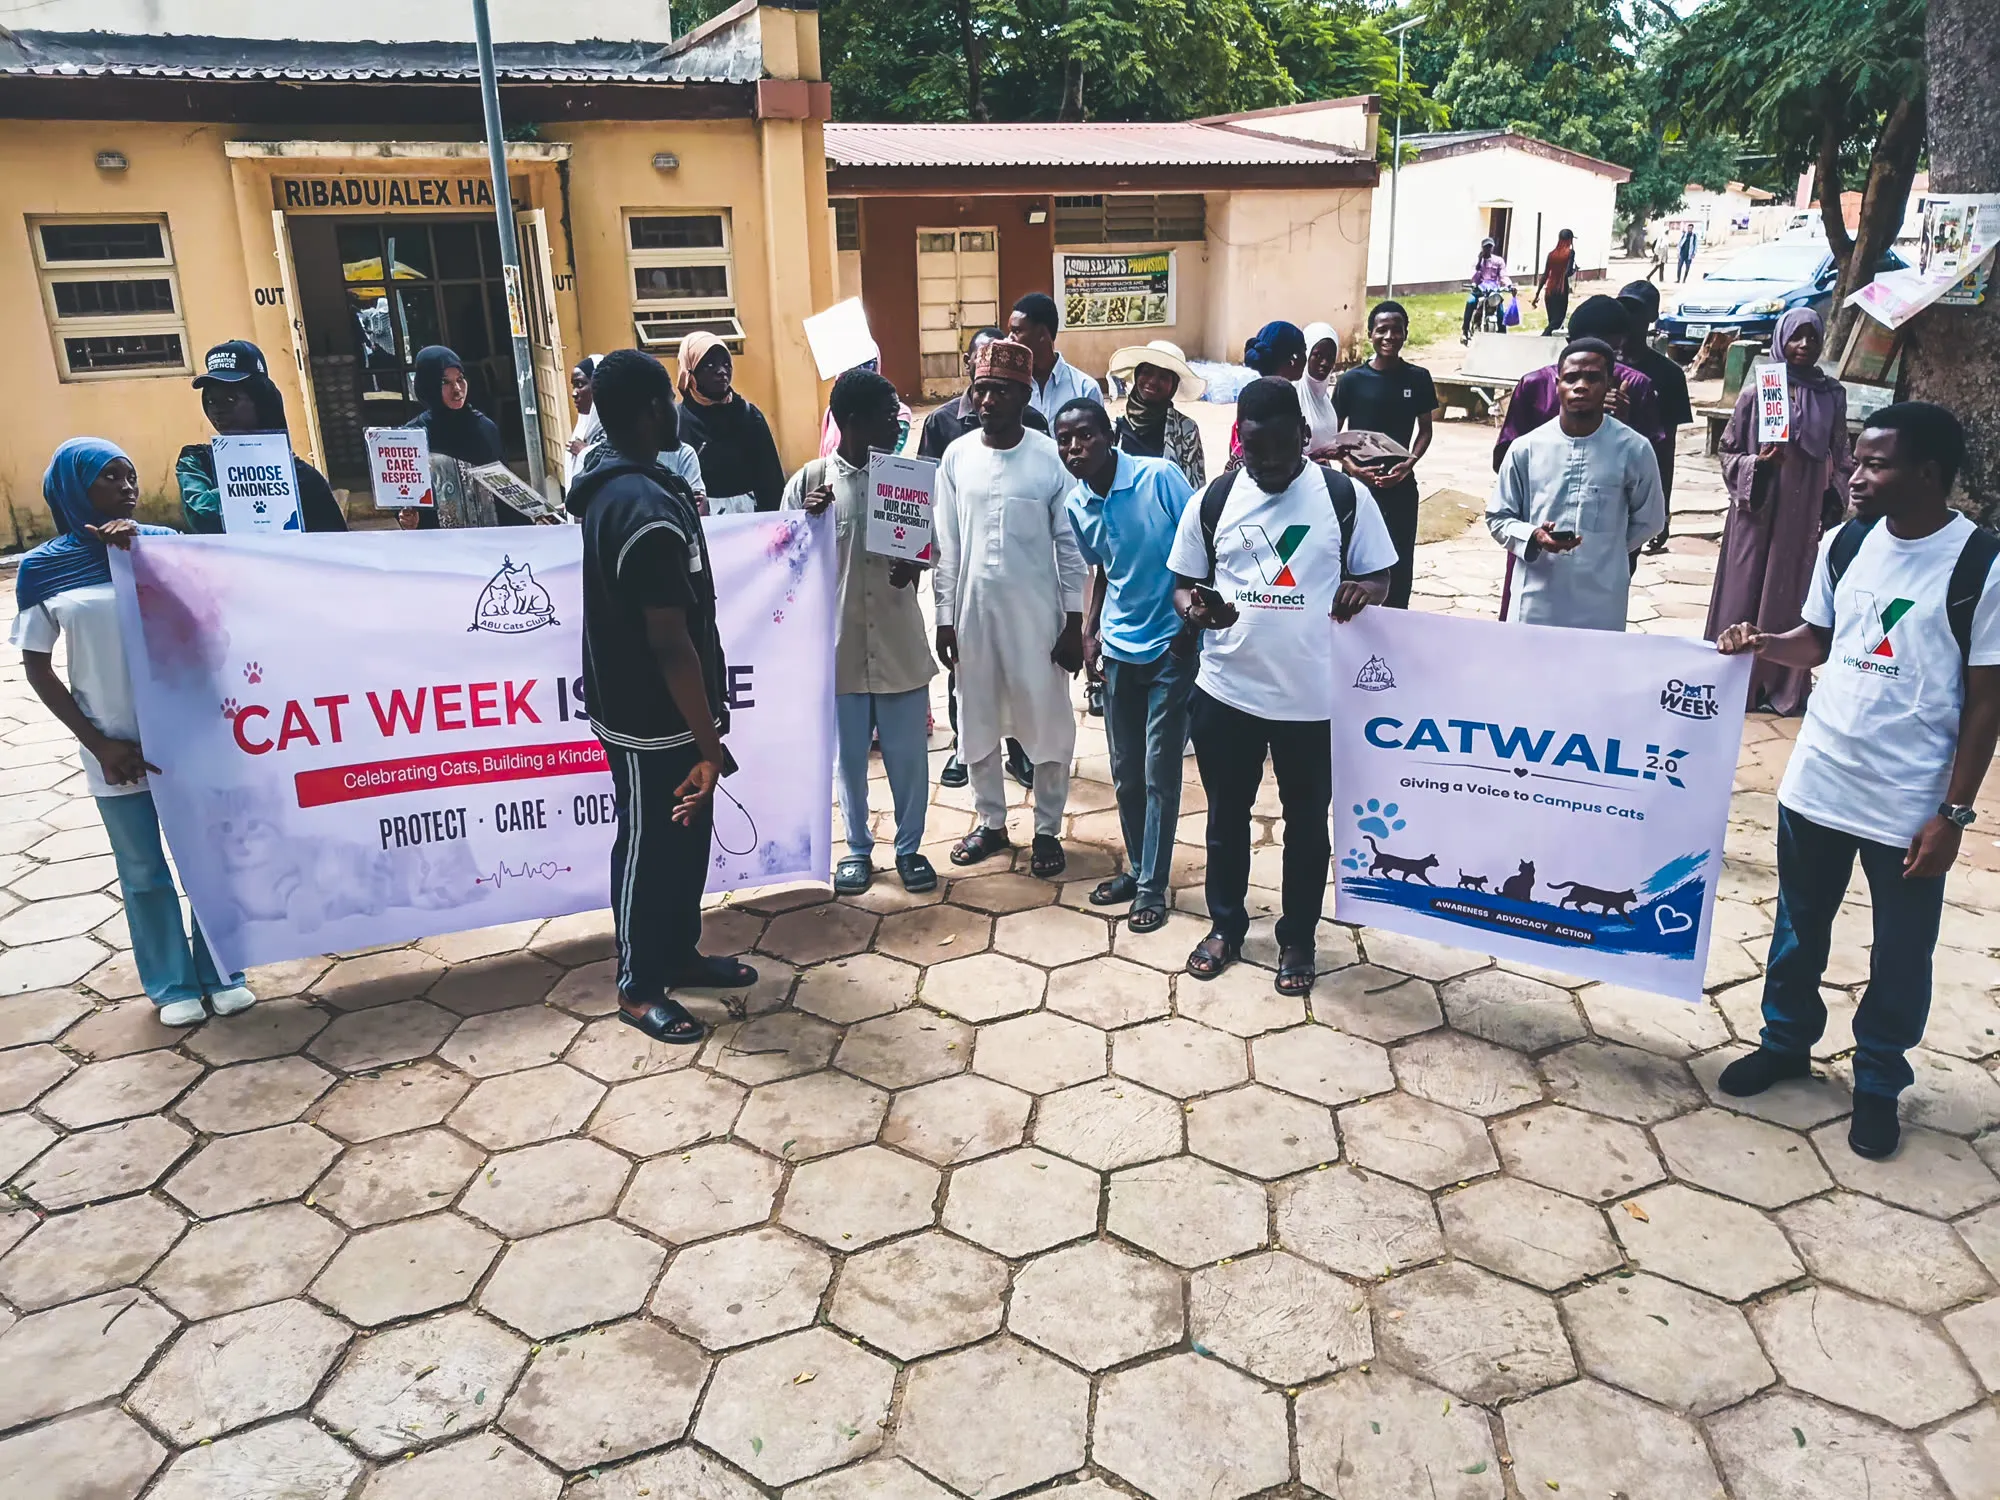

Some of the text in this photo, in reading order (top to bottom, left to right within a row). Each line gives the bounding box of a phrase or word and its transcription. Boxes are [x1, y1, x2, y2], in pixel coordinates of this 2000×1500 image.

[284, 179, 519, 207] RIBADU/ALEX HAL
[552, 274, 573, 292] UT
[254, 287, 285, 306] OUT
[1761, 373, 1782, 389] SMALL
[1765, 401, 1783, 416] BIG
[1764, 416, 1784, 427] IMPACT
[378, 446, 421, 459] PROTECT.
[227, 465, 284, 482] CHOOSE
[386, 458, 418, 472] CARE.
[381, 471, 425, 484] RESPECT.
[226, 481, 290, 498] KINDNESS
[876, 482, 931, 506] OUR CAMPUS.
[873, 509, 886, 521] OUR
[883, 498, 922, 518] OUR CATS.
[1235, 589, 1305, 605] Vetkonect
[480, 616, 547, 630] ABU Cats Club
[1659, 690, 1719, 716] WEEK
[233, 694, 349, 756] CAT
[366, 679, 543, 737] WEEK
[1364, 716, 1690, 789] CATWALK
[344, 748, 607, 789] Celebrating Cats, Building a Kinder
[1645, 754, 1678, 774] 2.0
[1399, 777, 1645, 821] Giving a Voice to Campus Cats
[379, 807, 467, 850] PROTECT
[495, 798, 547, 833] CARE
[1435, 900, 1592, 941] AWARENESS ADVOCACY ACTION
